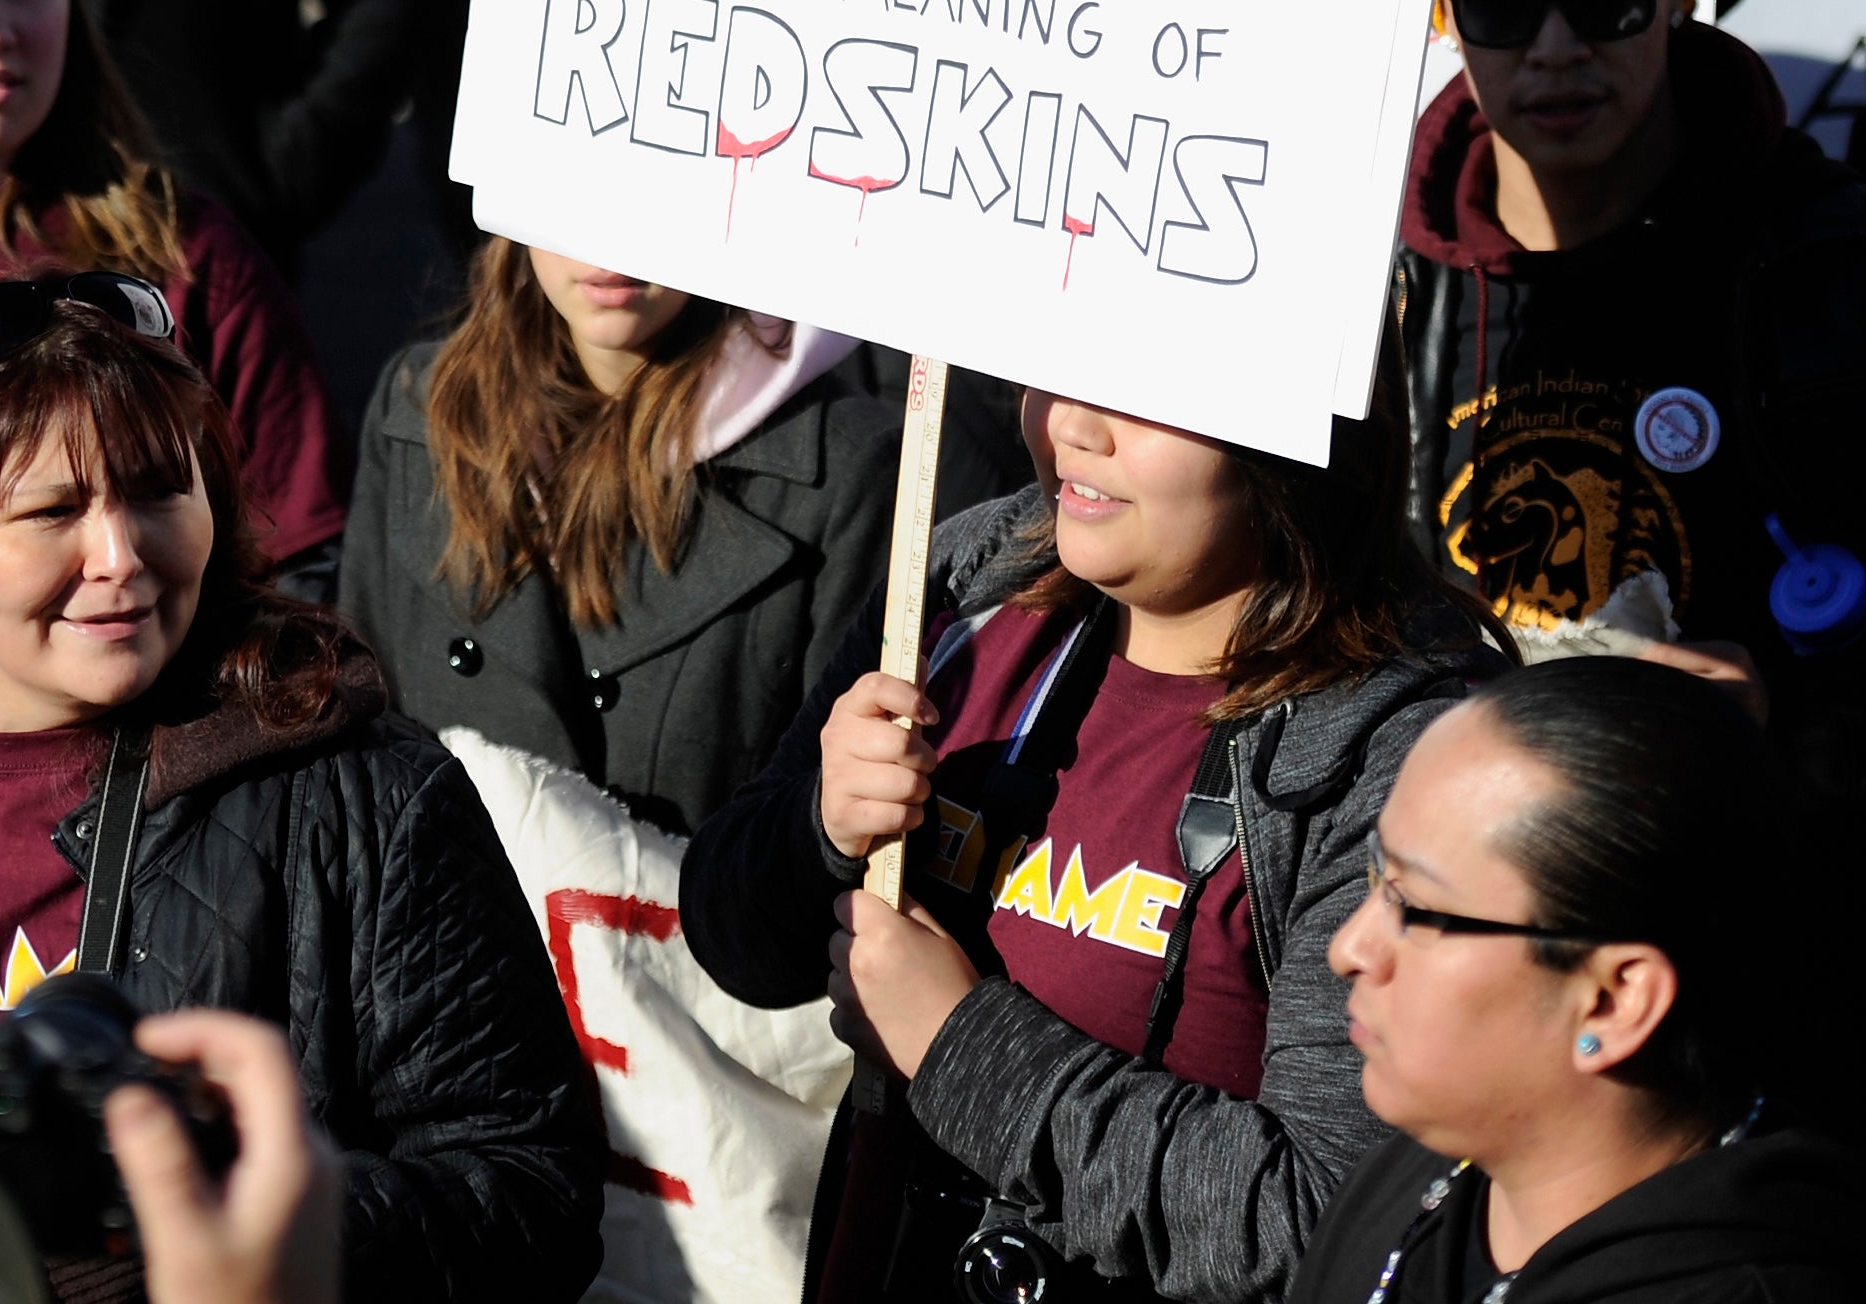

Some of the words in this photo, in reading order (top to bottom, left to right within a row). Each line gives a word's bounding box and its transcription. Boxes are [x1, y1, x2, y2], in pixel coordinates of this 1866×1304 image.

[1153, 21, 1230, 82] OF
[1537, 369, 1608, 396] Indian
[1480, 401, 1566, 436] ultural
